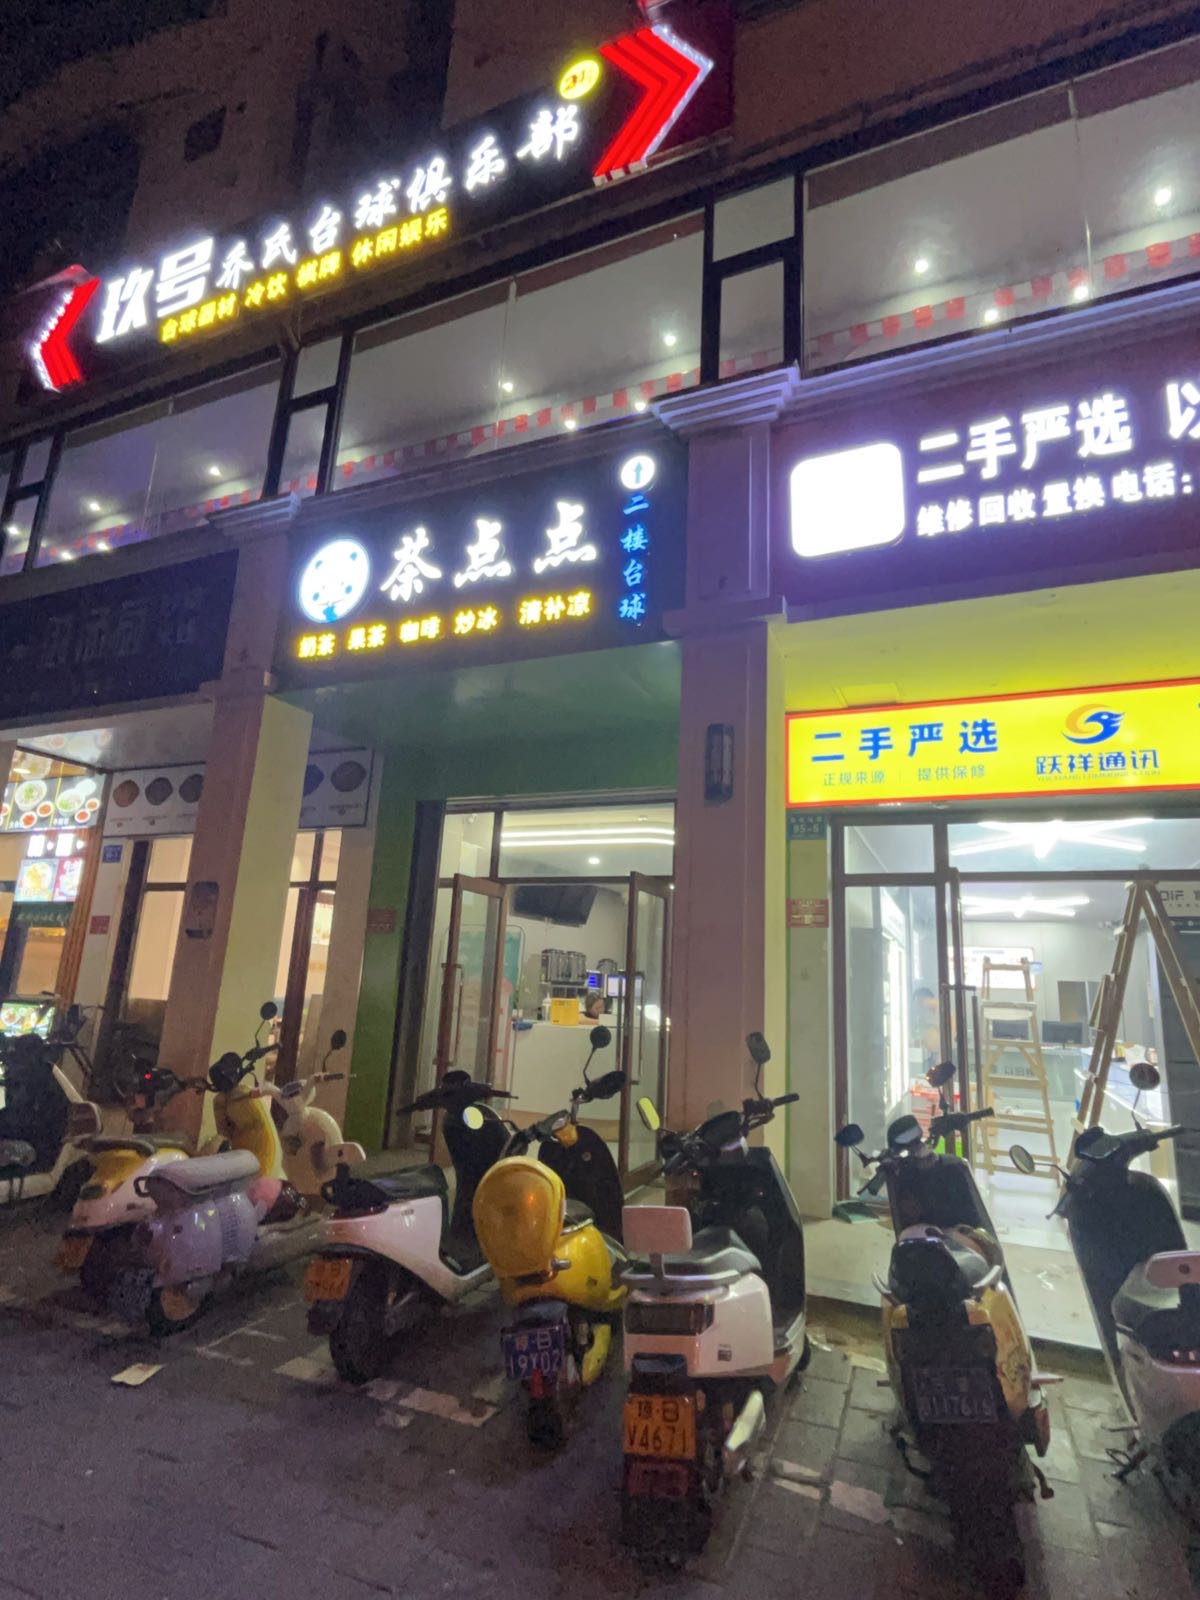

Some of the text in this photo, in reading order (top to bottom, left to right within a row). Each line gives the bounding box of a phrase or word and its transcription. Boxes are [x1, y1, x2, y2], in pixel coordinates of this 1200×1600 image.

[95, 105, 580, 344] 玖号 乔氏台球俱乐部
[244, 272, 288, 307] 冷饮
[351, 207, 448, 267] 休闲娱乐
[917, 393, 1132, 483] 二手严选
[381, 501, 597, 601] 茶点点
[618, 495, 649, 620] 二楼台球
[298, 591, 592, 660] 奶茶 果茶 咖啡 炒冰 清补凉
[811, 718, 998, 763] 二手严选
[823, 765, 985, 786] 正规来源 提供保修
[1036, 749, 1159, 775] 跃祥通讯
[628, 1425, 687, 1453] V4671
